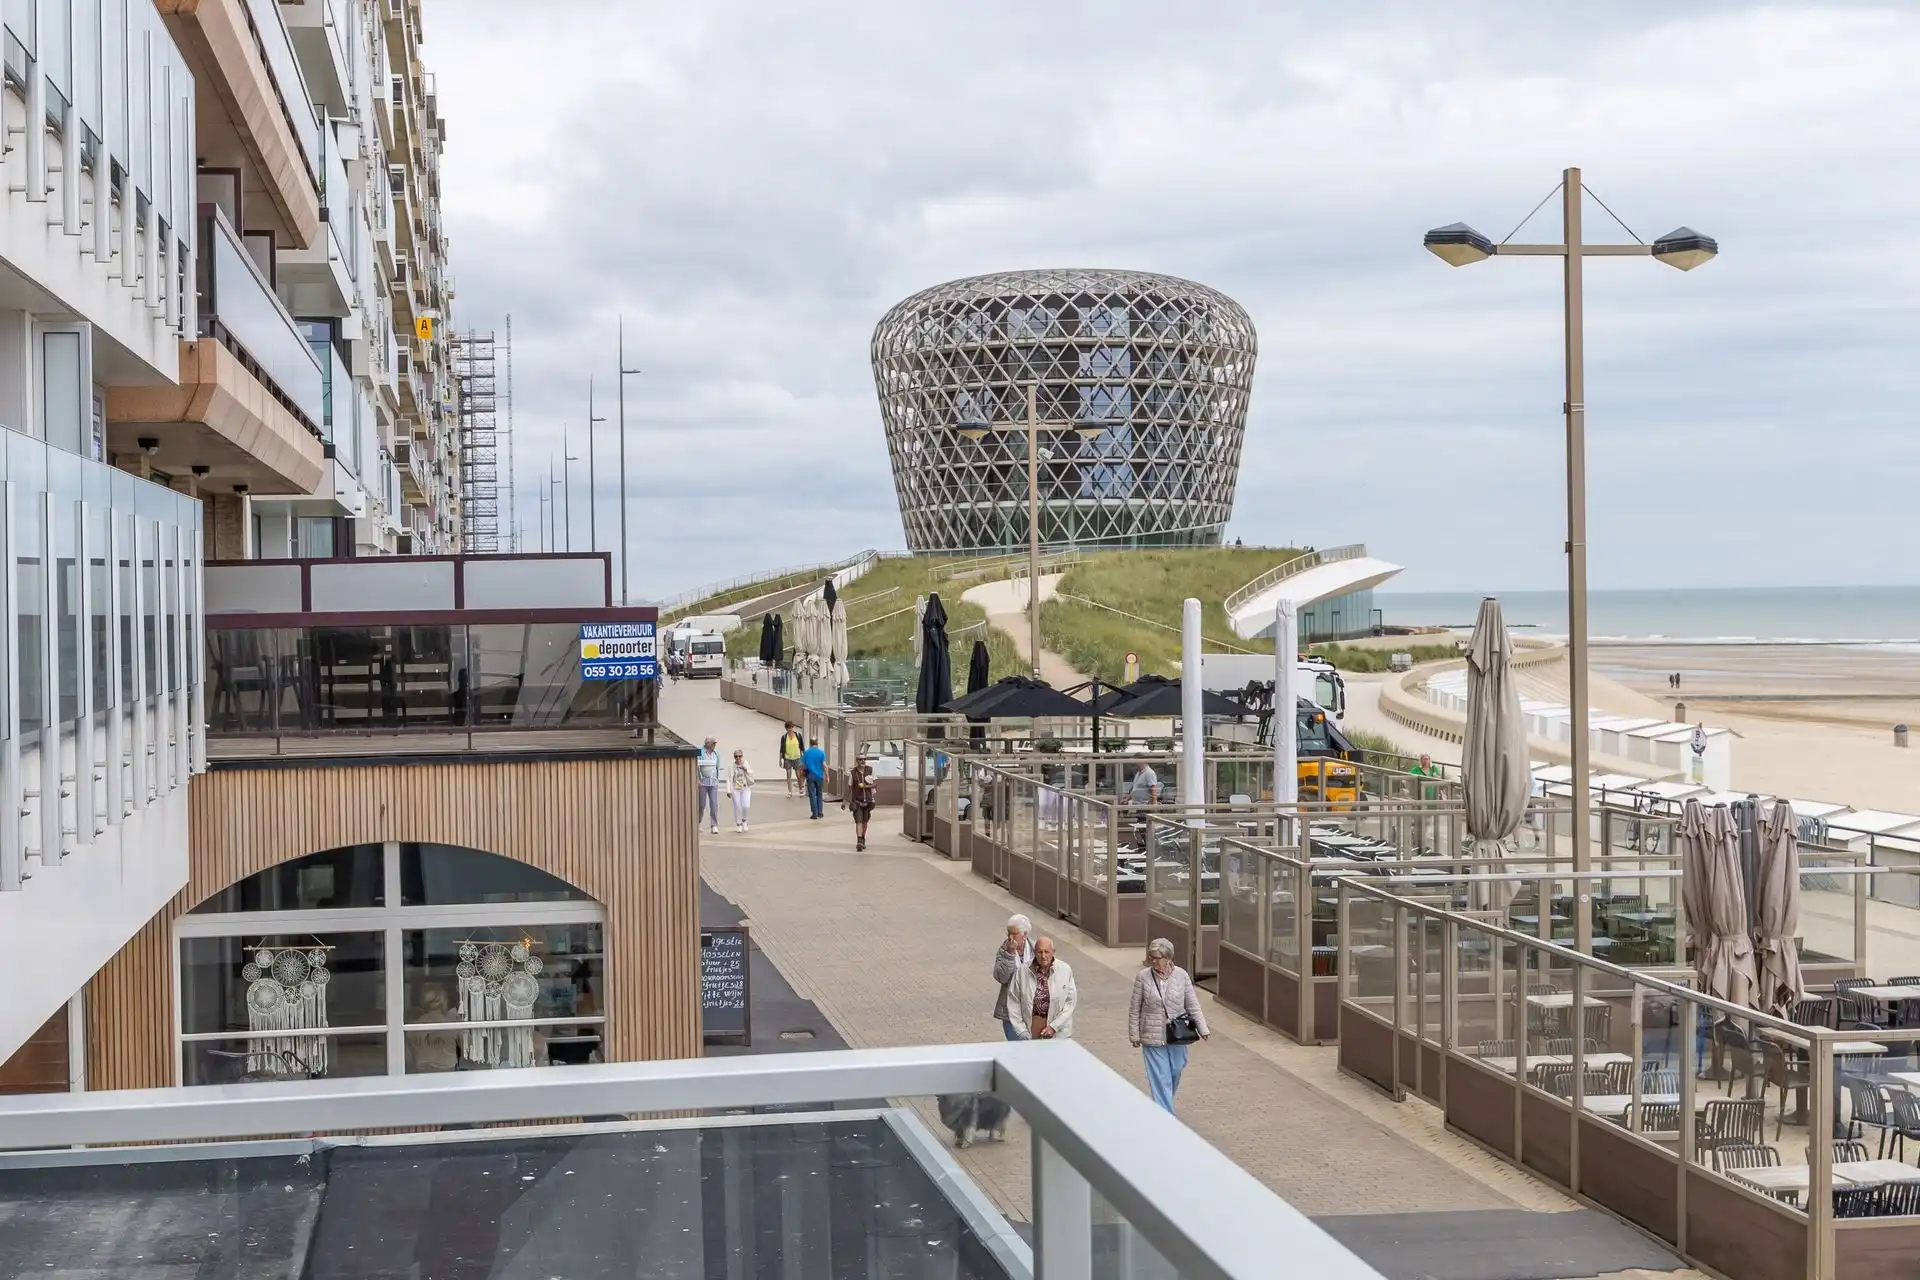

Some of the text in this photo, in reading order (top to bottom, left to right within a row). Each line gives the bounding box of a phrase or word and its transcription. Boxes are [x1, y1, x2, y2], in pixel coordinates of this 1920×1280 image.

[421, 320, 429, 331] A
[583, 623, 653, 638] VAKANTIEVERHUUR
[598, 639, 653, 657] depoorter
[584, 664, 654, 678] 059 30 28 56
[1333, 767, 1352, 775] JCB
